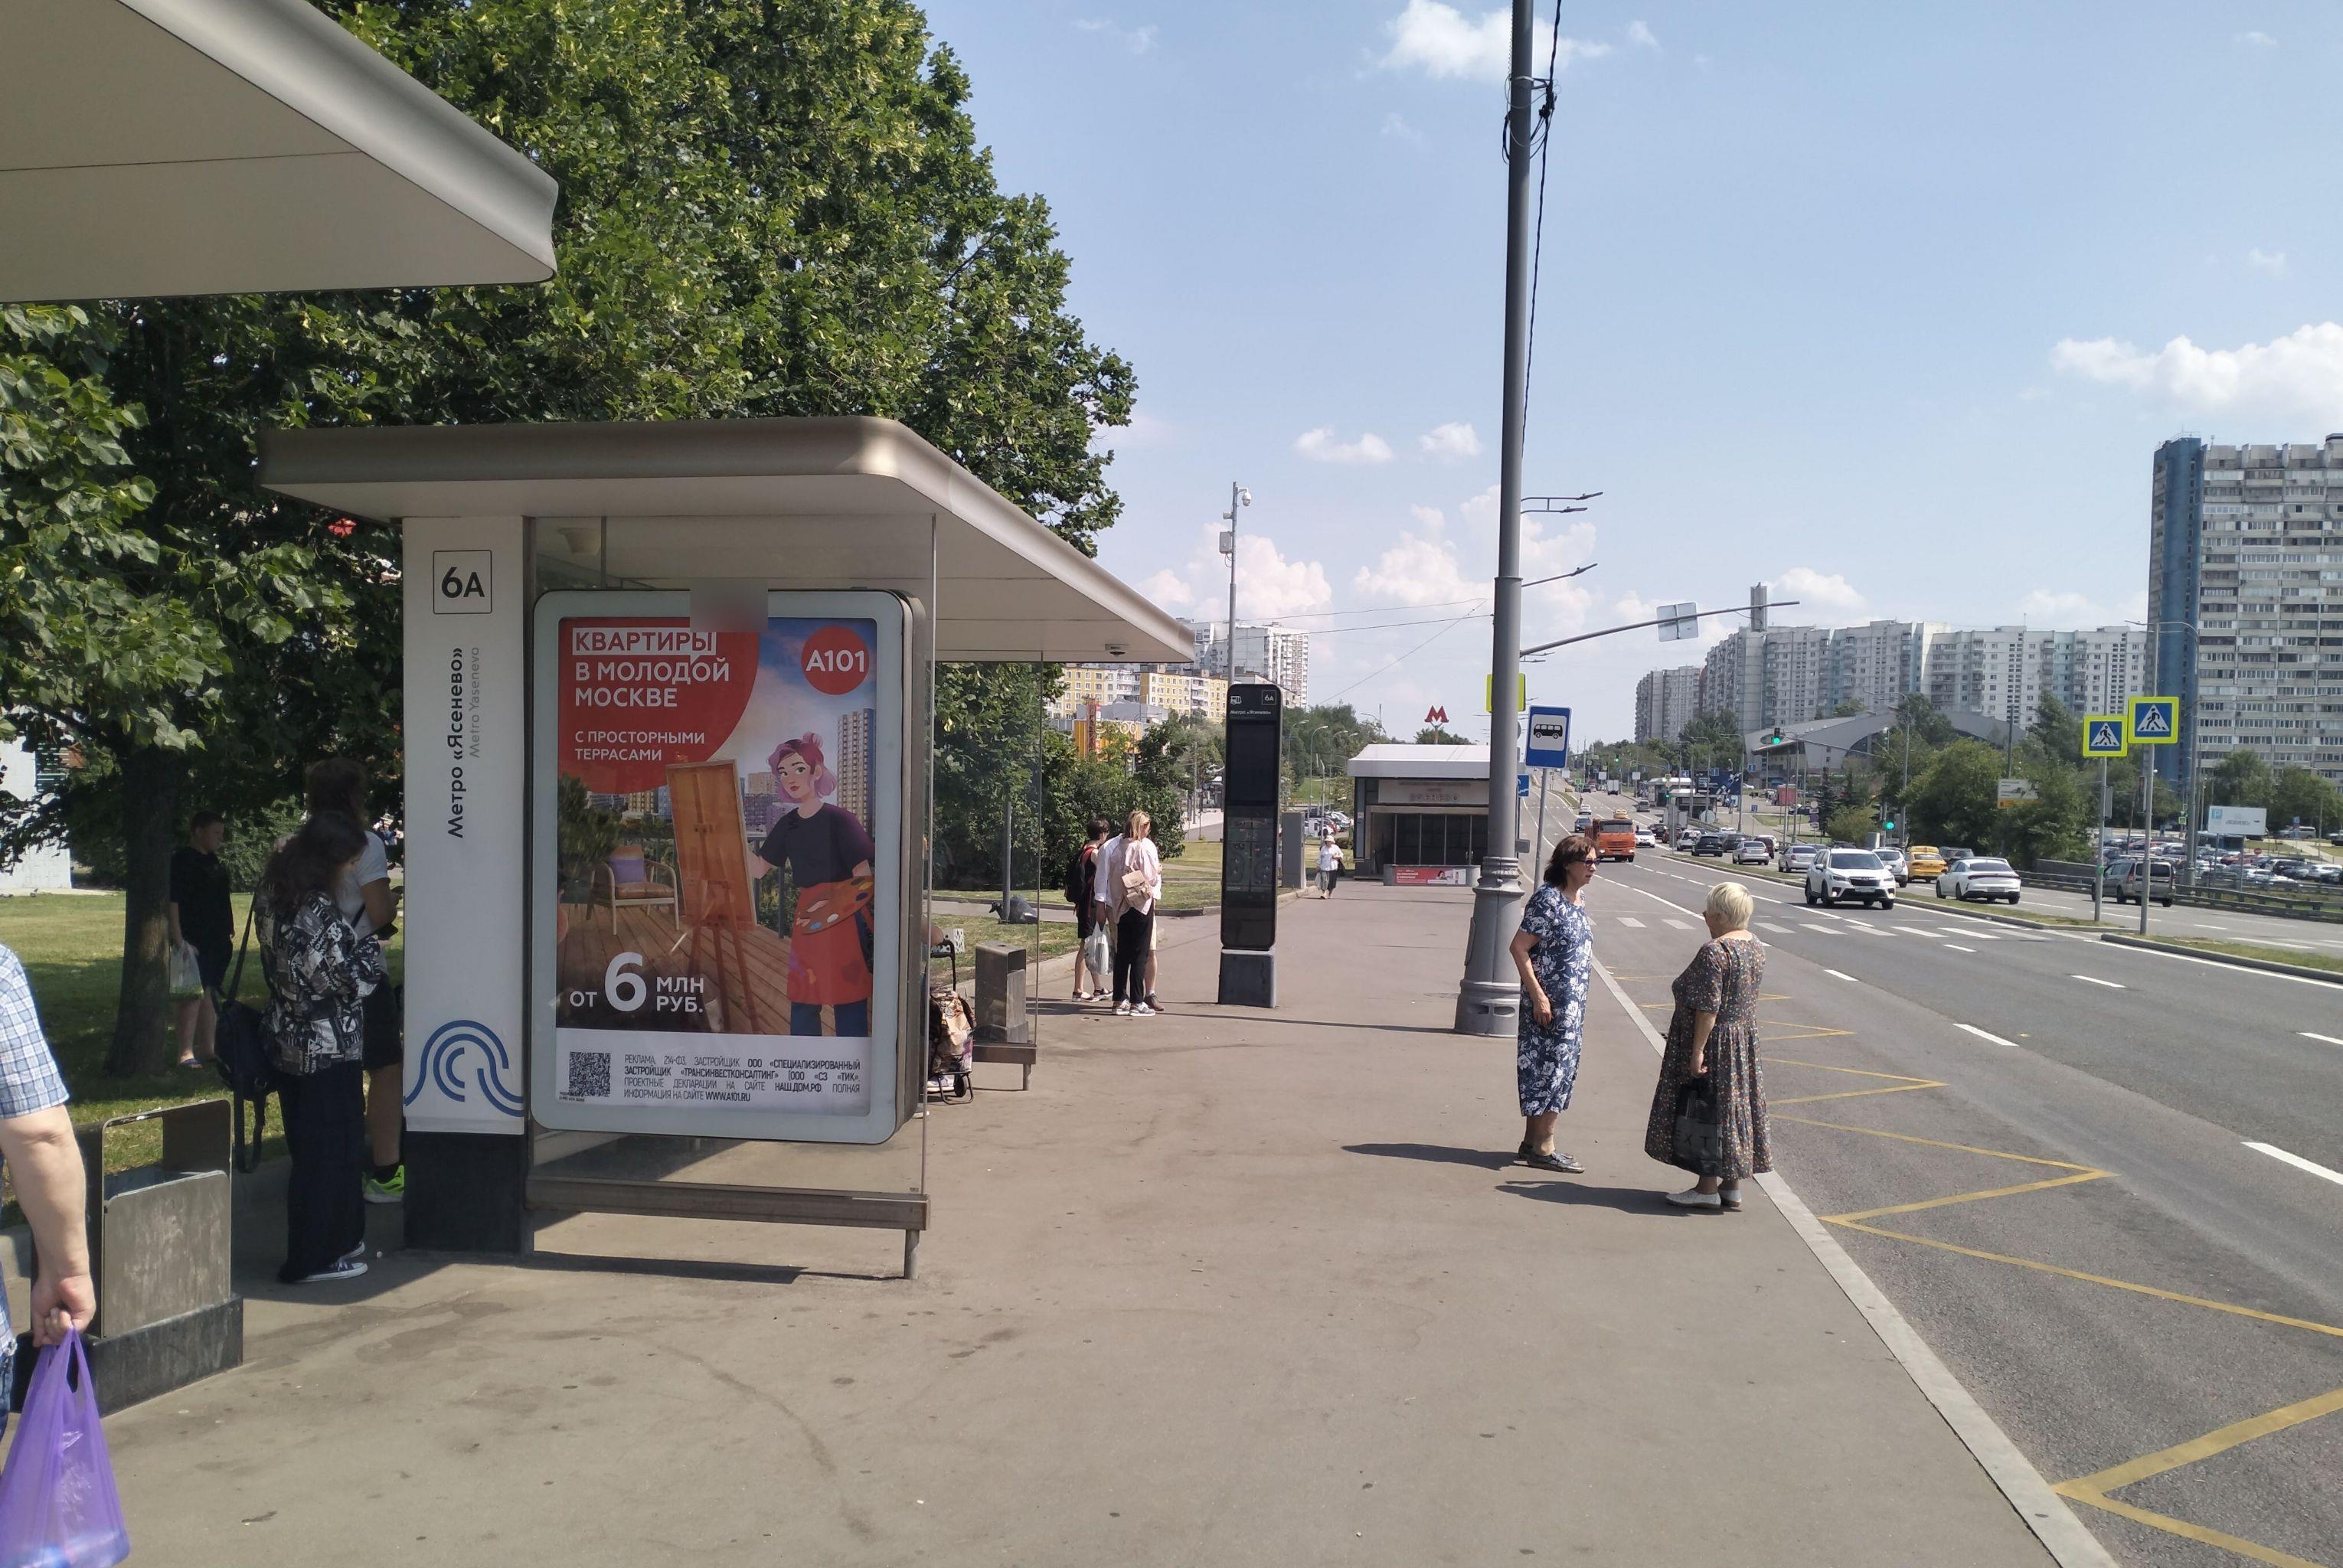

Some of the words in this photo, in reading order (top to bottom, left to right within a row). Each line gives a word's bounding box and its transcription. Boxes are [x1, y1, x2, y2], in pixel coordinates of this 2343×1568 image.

[441, 567, 485, 599] 6А
[576, 632, 713, 651] КВАРТИРЫ
[469, 647, 480, 714] Yasenevo
[576, 662, 590, 681] В
[597, 657, 730, 685] МОЛОДОЙ
[447, 647, 463, 758] «Ясенево»
[576, 688, 678, 707] МОСКВЕ
[469, 714, 480, 758] Metro
[575, 731, 583, 743] С
[587, 731, 705, 744] ПРОСТОРНЫМИ
[575, 748, 662, 761] ТЕРРАСАМИ
[448, 766, 467, 839] Метро
[570, 990, 598, 1007] ОТ
[604, 952, 647, 1012] 6
[656, 976, 704, 994] МЛН
[656, 996, 704, 1013] РУБ.
[624, 1065, 672, 1076] ЗАСТРОЙЩИК
[681, 1067, 779, 1080] «ТРАНСИНВЕСТКОНСАЛТИНГ»
[694, 1056, 740, 1067] ЗАСТРОЙЩИК
[747, 1058, 763, 1068] ООО
[770, 1059, 861, 1070] «СПЕЦИАЛИЗИРОВАННЫЙ
[624, 1077, 664, 1088] ПРОЕКТНЫЕ
[673, 1078, 717, 1089] ДЕКЛАРАЦИИ
[726, 1080, 735, 1089] НА
[744, 1080, 766, 1091] САЙТЕ
[832, 1083, 860, 1093] ПОЛНАЯ
[624, 1089, 672, 1099] ИНФОРМАЦИЯ
[673, 1090, 682, 1099] НА
[683, 1089, 704, 1100] САЙТЕ
